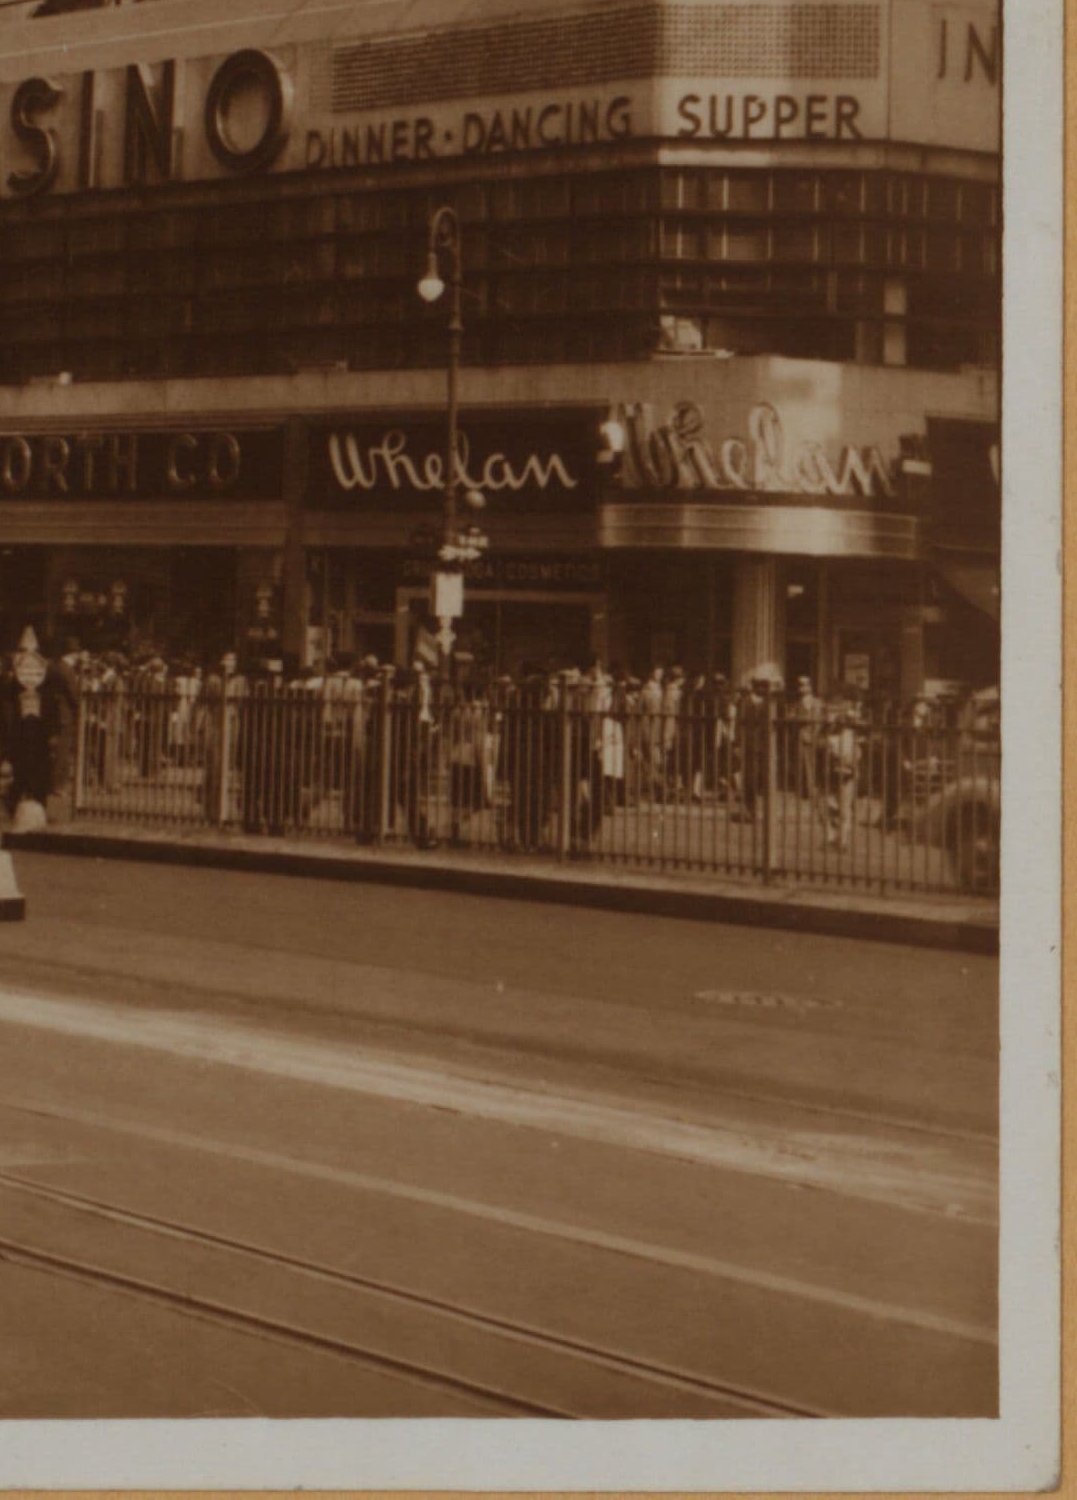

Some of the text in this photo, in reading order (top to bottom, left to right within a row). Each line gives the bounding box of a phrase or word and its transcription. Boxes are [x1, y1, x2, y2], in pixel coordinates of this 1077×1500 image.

[675, 94, 863, 141] SUPPER
[328, 427, 579, 491] Whelan
[619, 402, 902, 497] Whelan
